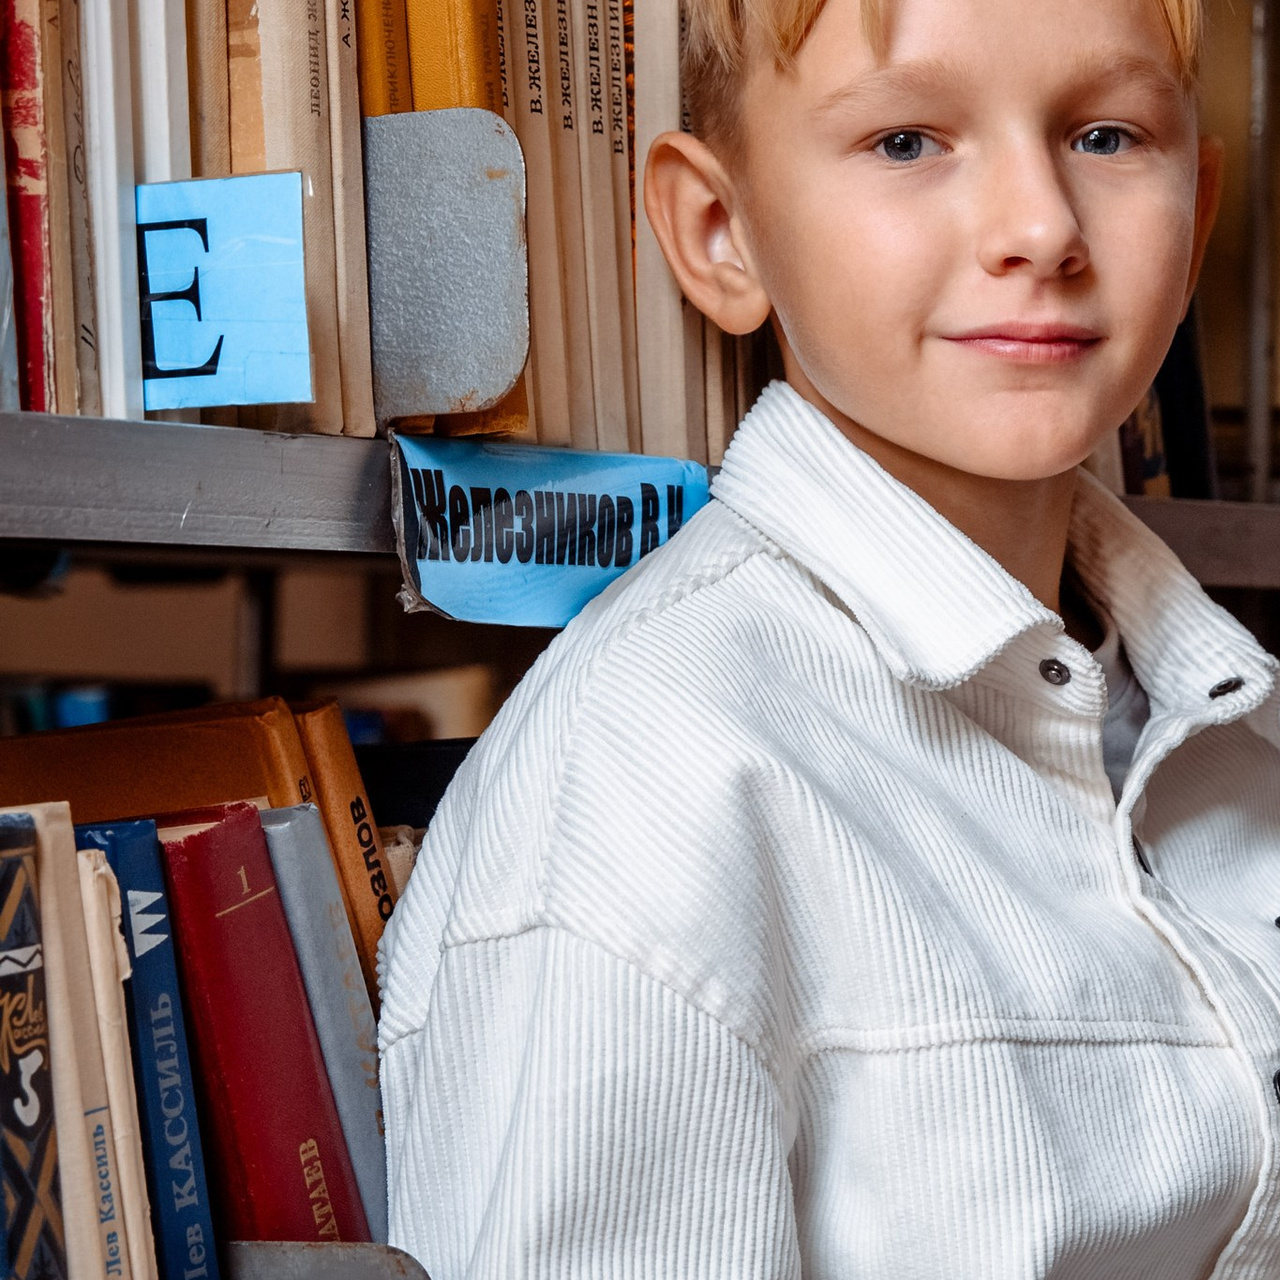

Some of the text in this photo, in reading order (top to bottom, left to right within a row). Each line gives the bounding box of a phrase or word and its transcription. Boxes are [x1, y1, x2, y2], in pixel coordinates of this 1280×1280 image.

[305, 28, 324, 118] ЛЕОНИД
[136, 218, 224, 381] Е
[409, 468, 635, 568] Железников
[236, 865, 251, 897] 1
[350, 795, 395, 922] ОЗЛОВ
[151, 992, 200, 1213] КАССИЛЬ
[93, 1123, 121, 1276] Лев Кассиль
[299, 1137, 341, 1242] АТАЕВ
